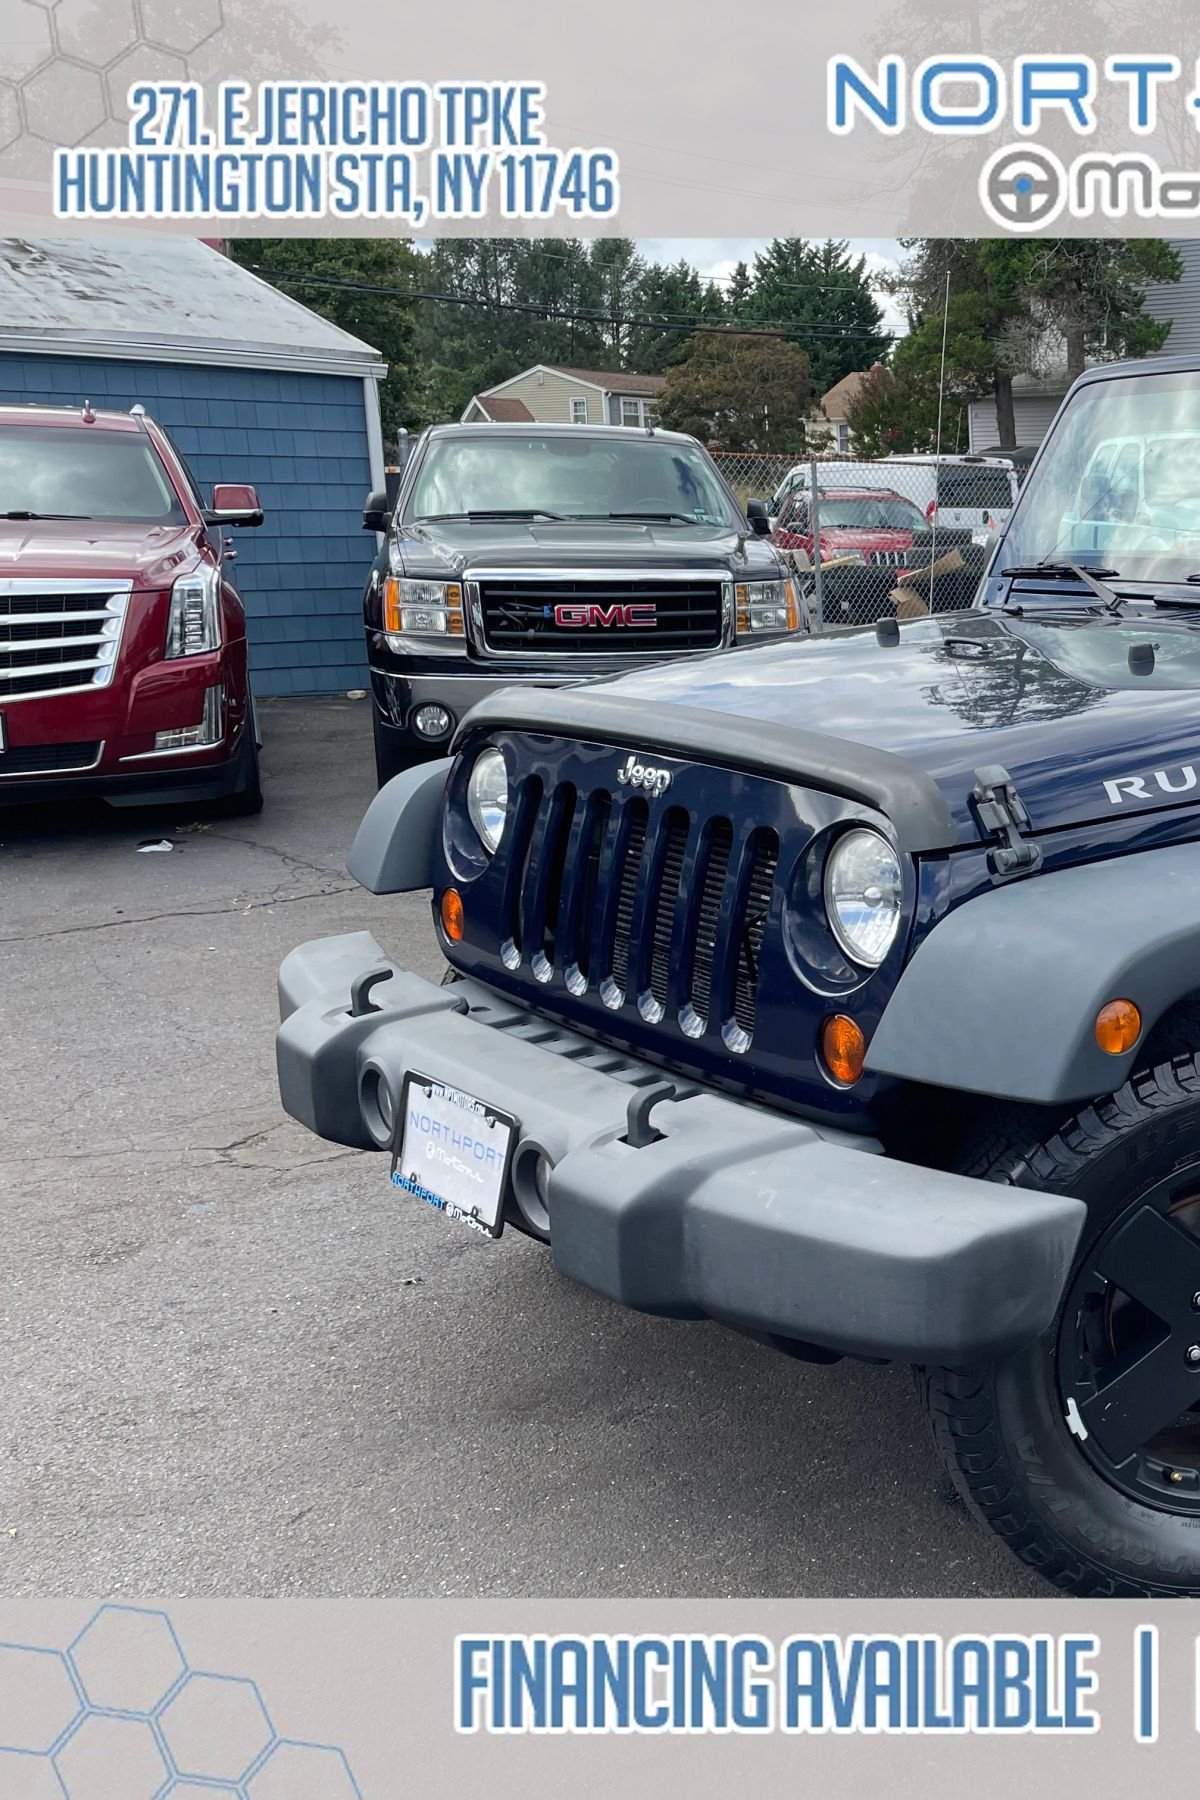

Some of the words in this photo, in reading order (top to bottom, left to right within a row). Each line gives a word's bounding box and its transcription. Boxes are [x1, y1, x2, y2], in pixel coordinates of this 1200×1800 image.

[554, 604, 657, 627] GMC
[617, 756, 673, 798] Jeep
[410, 1110, 505, 1171] NORTHPORT
[391, 1172, 446, 1210] NORTHPORT
